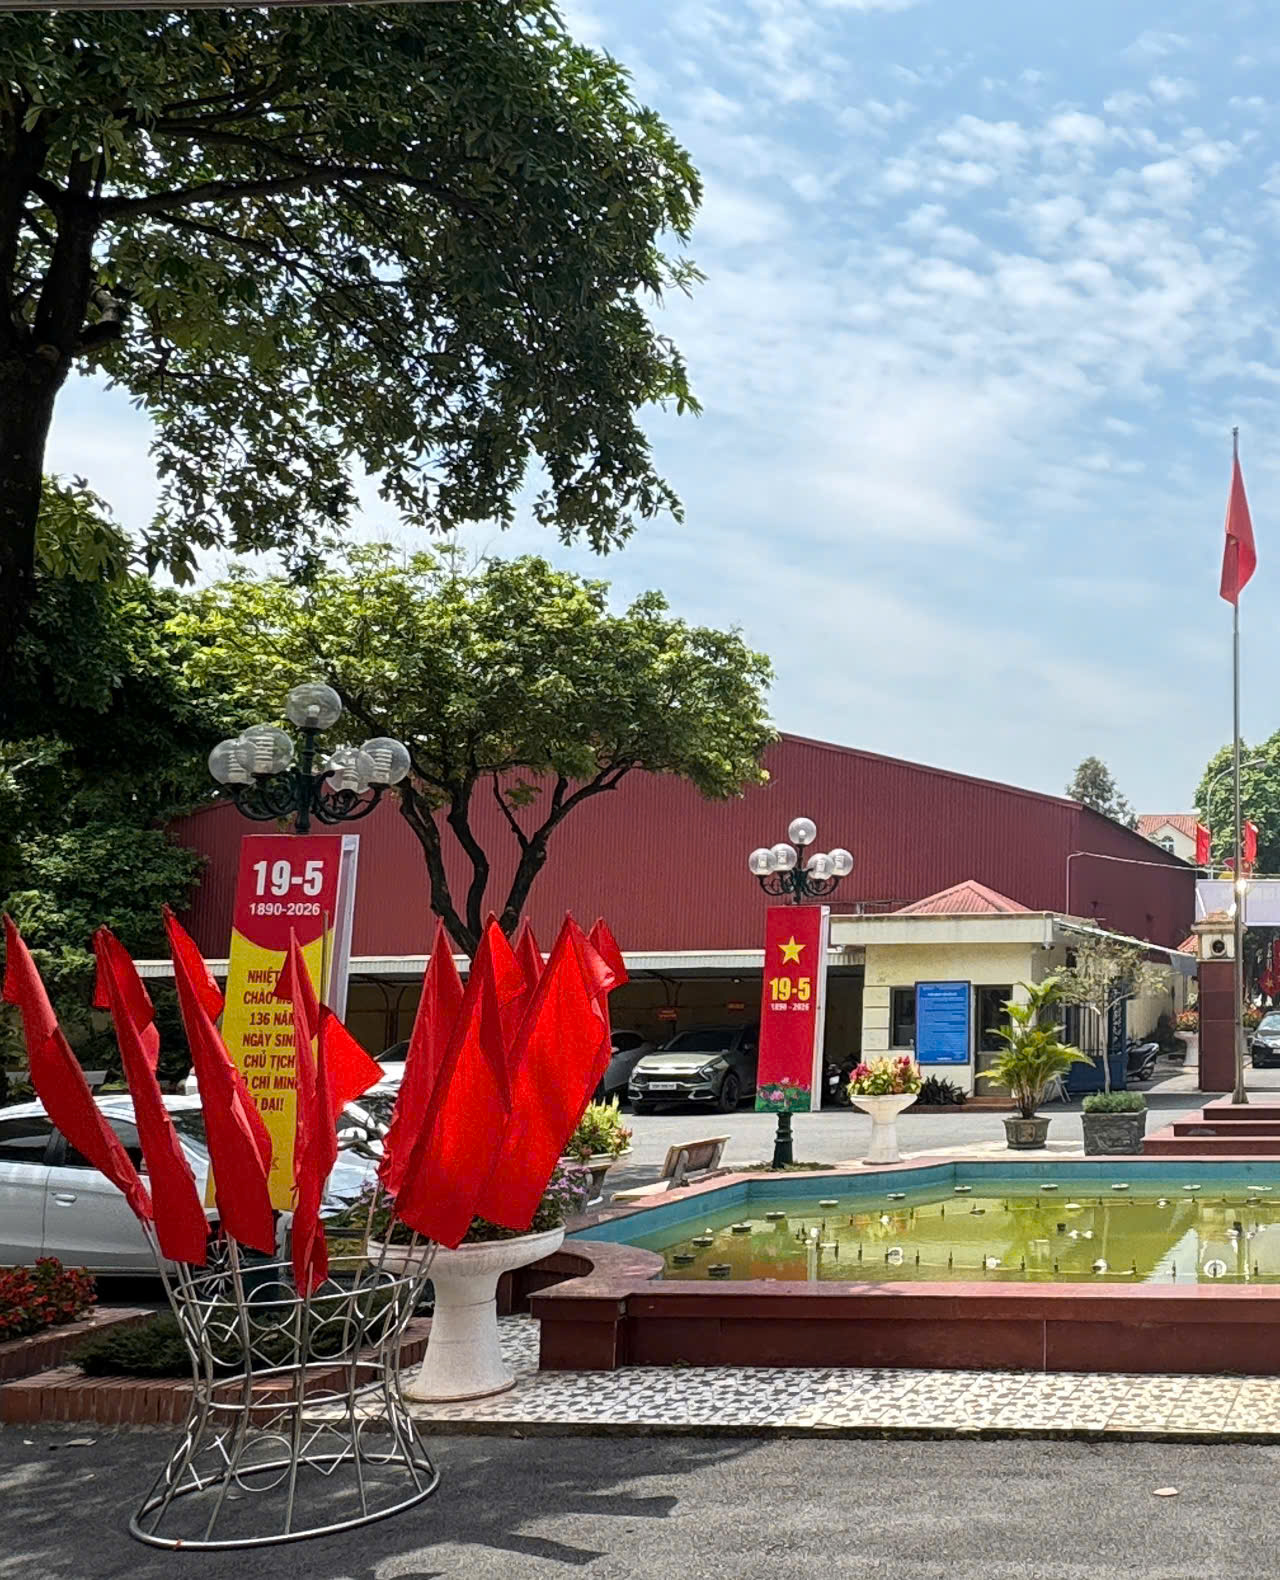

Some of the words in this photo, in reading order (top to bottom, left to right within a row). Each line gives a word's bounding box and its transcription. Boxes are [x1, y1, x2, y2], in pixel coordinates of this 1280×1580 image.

[253, 860, 324, 896] 19-5
[249, 902, 320, 916] 1890-2026
[247, 966, 280, 986] NHIỆT
[243, 988, 273, 1005] CHÀO
[769, 977, 811, 1001] 19-5
[249, 1012, 270, 1025] 136
[243, 1029, 272, 1047] NGÀY
[275, 1033, 296, 1047] SIN
[244, 1049, 266, 1068] CHỦ
[270, 1054, 296, 1071] TỊCH
[252, 1072, 270, 1089] CHÍ
[261, 1097, 284, 1114] ĐẠI!
